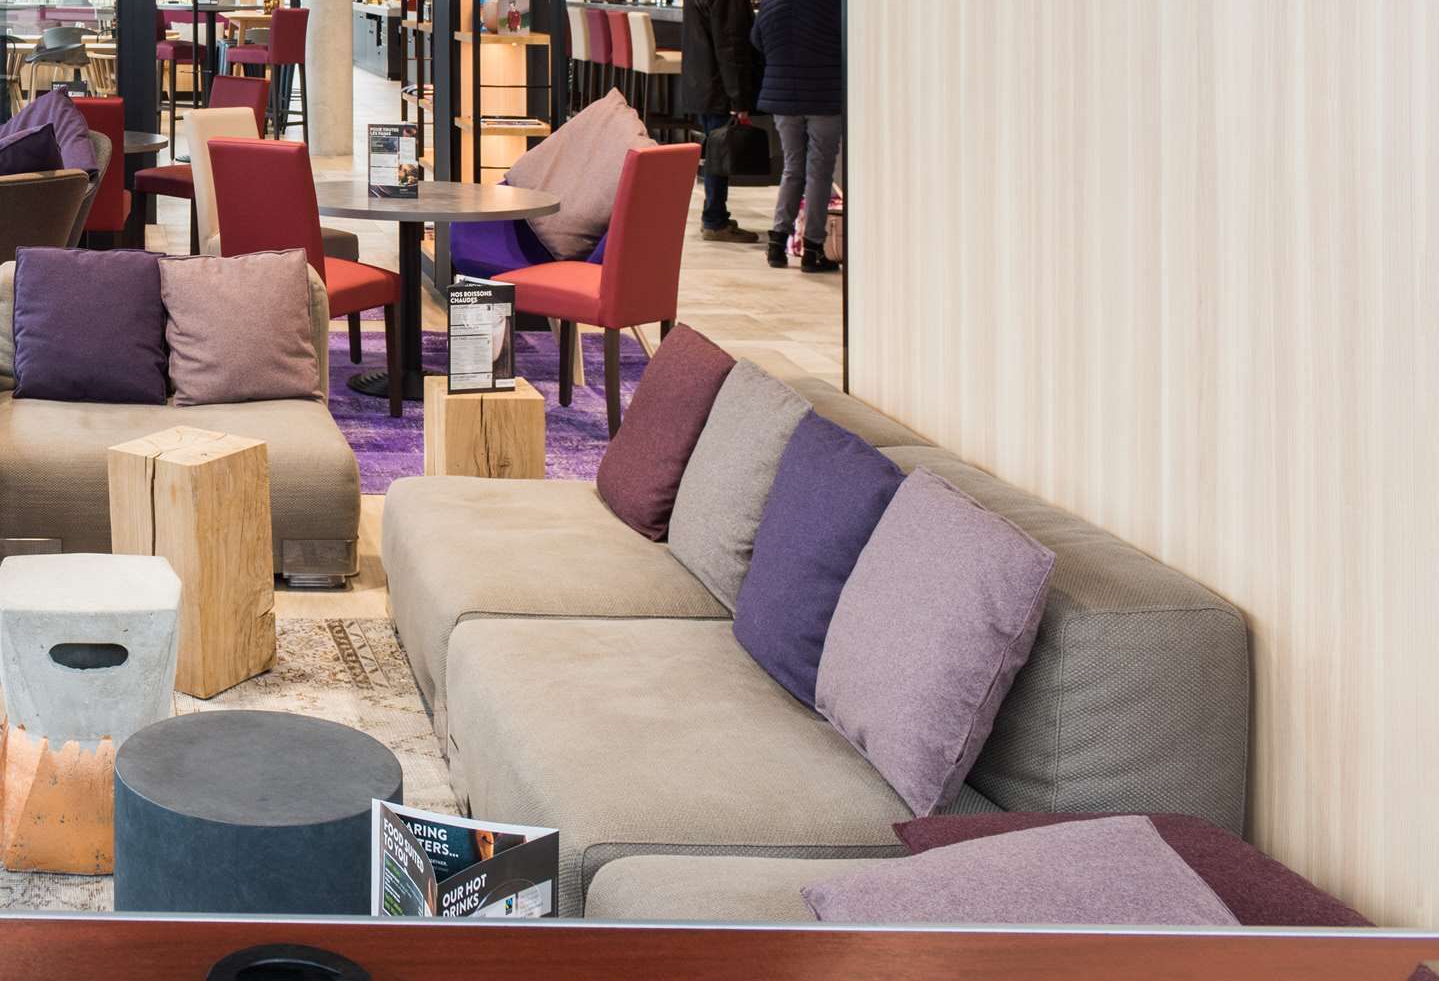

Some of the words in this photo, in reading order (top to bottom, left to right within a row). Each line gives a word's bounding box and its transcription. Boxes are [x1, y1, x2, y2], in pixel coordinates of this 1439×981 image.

[384, 818, 403, 847] FOOD
[404, 839, 424, 873] SUITED
[384, 832, 393, 850] TO
[394, 843, 408, 867] YOU
[442, 885, 464, 907] OUR
[465, 873, 487, 893] HOT
[442, 892, 479, 917] DRINKS
